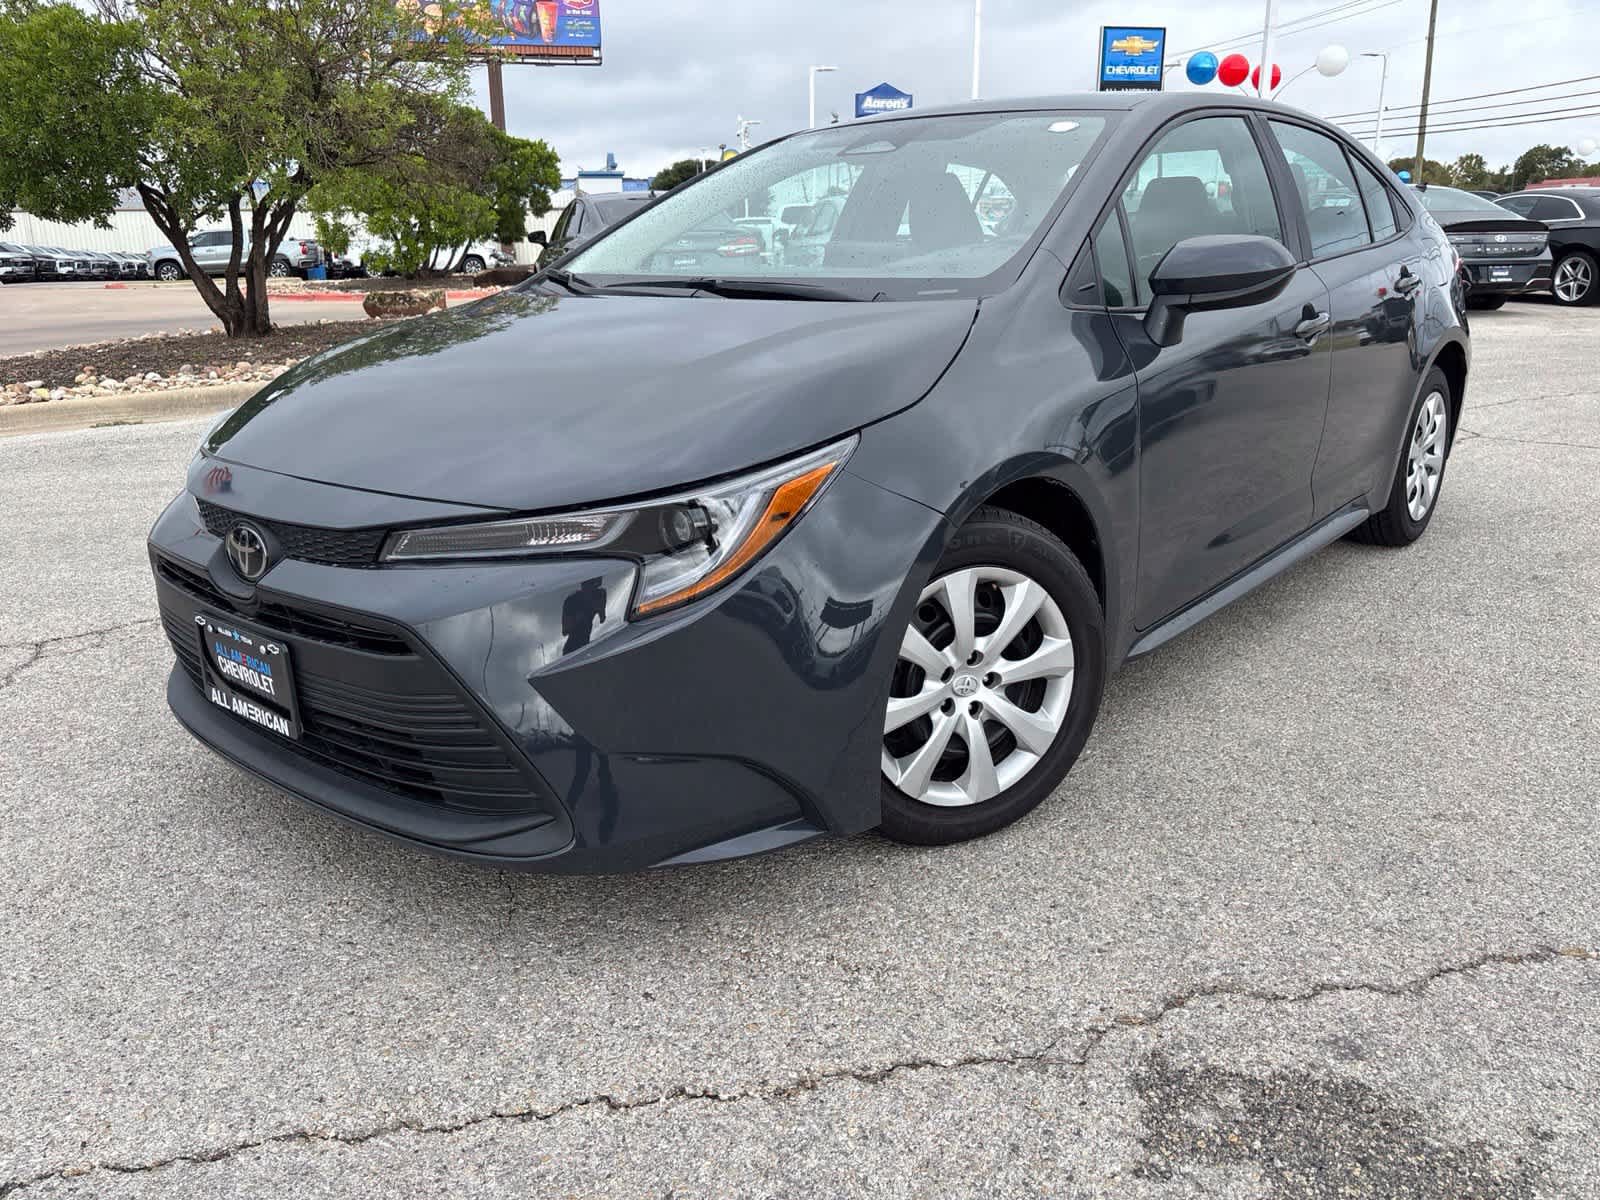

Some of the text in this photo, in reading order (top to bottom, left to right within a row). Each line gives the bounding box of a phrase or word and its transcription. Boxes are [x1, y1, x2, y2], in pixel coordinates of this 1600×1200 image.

[1105, 65, 1159, 75] CHEVROLET
[863, 95, 909, 110] Aaron's
[214, 641, 272, 676] ALL AMERICAN
[217, 655, 276, 696] CHEVROLET
[211, 687, 290, 737] ALL AMERICAN
